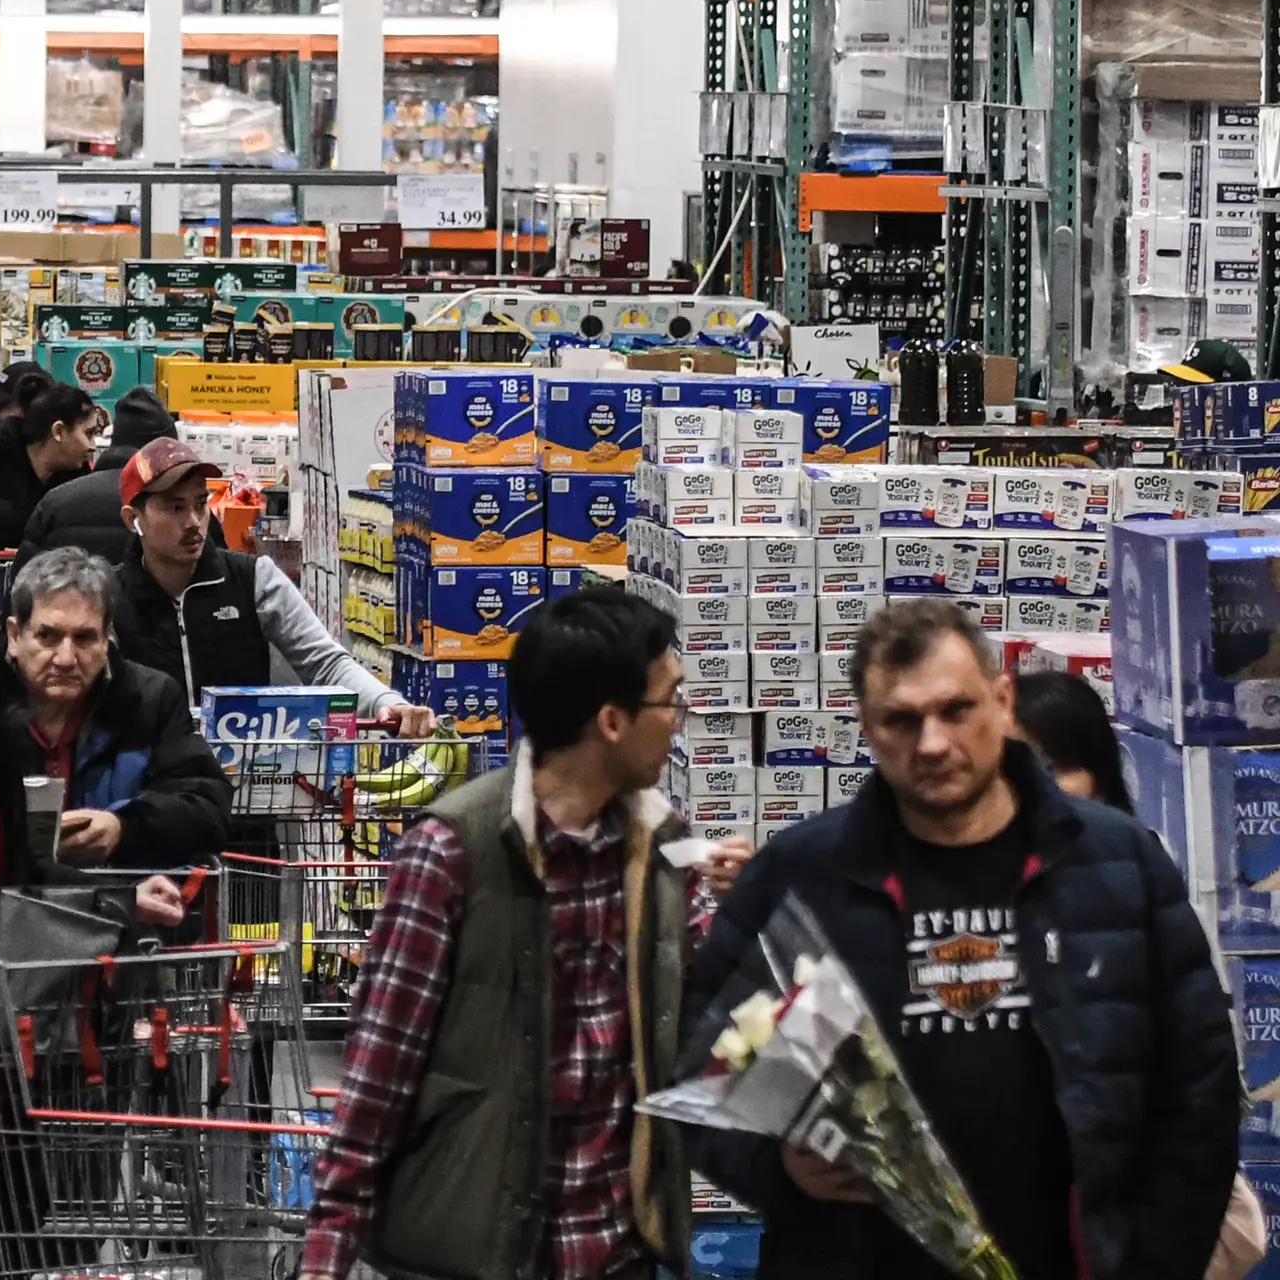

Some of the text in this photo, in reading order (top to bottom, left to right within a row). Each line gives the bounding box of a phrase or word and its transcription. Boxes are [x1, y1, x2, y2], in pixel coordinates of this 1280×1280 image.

[2, 208, 56, 222] 199.99
[437, 211, 483, 226] 34.99
[1227, 210, 1246, 218] QT
[814, 328, 853, 338] Chosen
[236, 385, 272, 395] HONEY
[500, 379, 518, 393] 18
[624, 388, 642, 402] 18
[733, 388, 752, 402] 18
[849, 391, 868, 405] 18
[1248, 387, 1258, 400] 8
[675, 415, 701, 426] GoGo
[754, 419, 780, 431] GoGo
[506, 476, 525, 491] 18
[684, 475, 710, 487] GoGo
[753, 474, 779, 486] GoGo
[885, 478, 916, 492] GoGo
[1005, 480, 1036, 493] GoGo
[1134, 476, 1166, 490] GoGo
[830, 484, 857, 496] GoGo
[698, 543, 724, 556] GoGo
[766, 543, 792, 555] GoGo
[833, 542, 860, 554] GoGo
[896, 544, 928, 557] GoGo
[1018, 545, 1049, 558] GoGo
[510, 571, 528, 585] 18
[698, 600, 725, 612] GoGo
[766, 599, 793, 612] GoGo
[836, 599, 863, 612] GoGo
[1019, 602, 1051, 615] GoGo
[487, 663, 498, 672] 18
[699, 657, 725, 670] GoGo
[770, 657, 797, 669] GoGo
[777, 716, 808, 730] GoGo
[215, 706, 301, 768] Silk
[706, 772, 733, 784] GoGo
[774, 771, 800, 783] GoGo
[705, 828, 732, 839] GoGo
